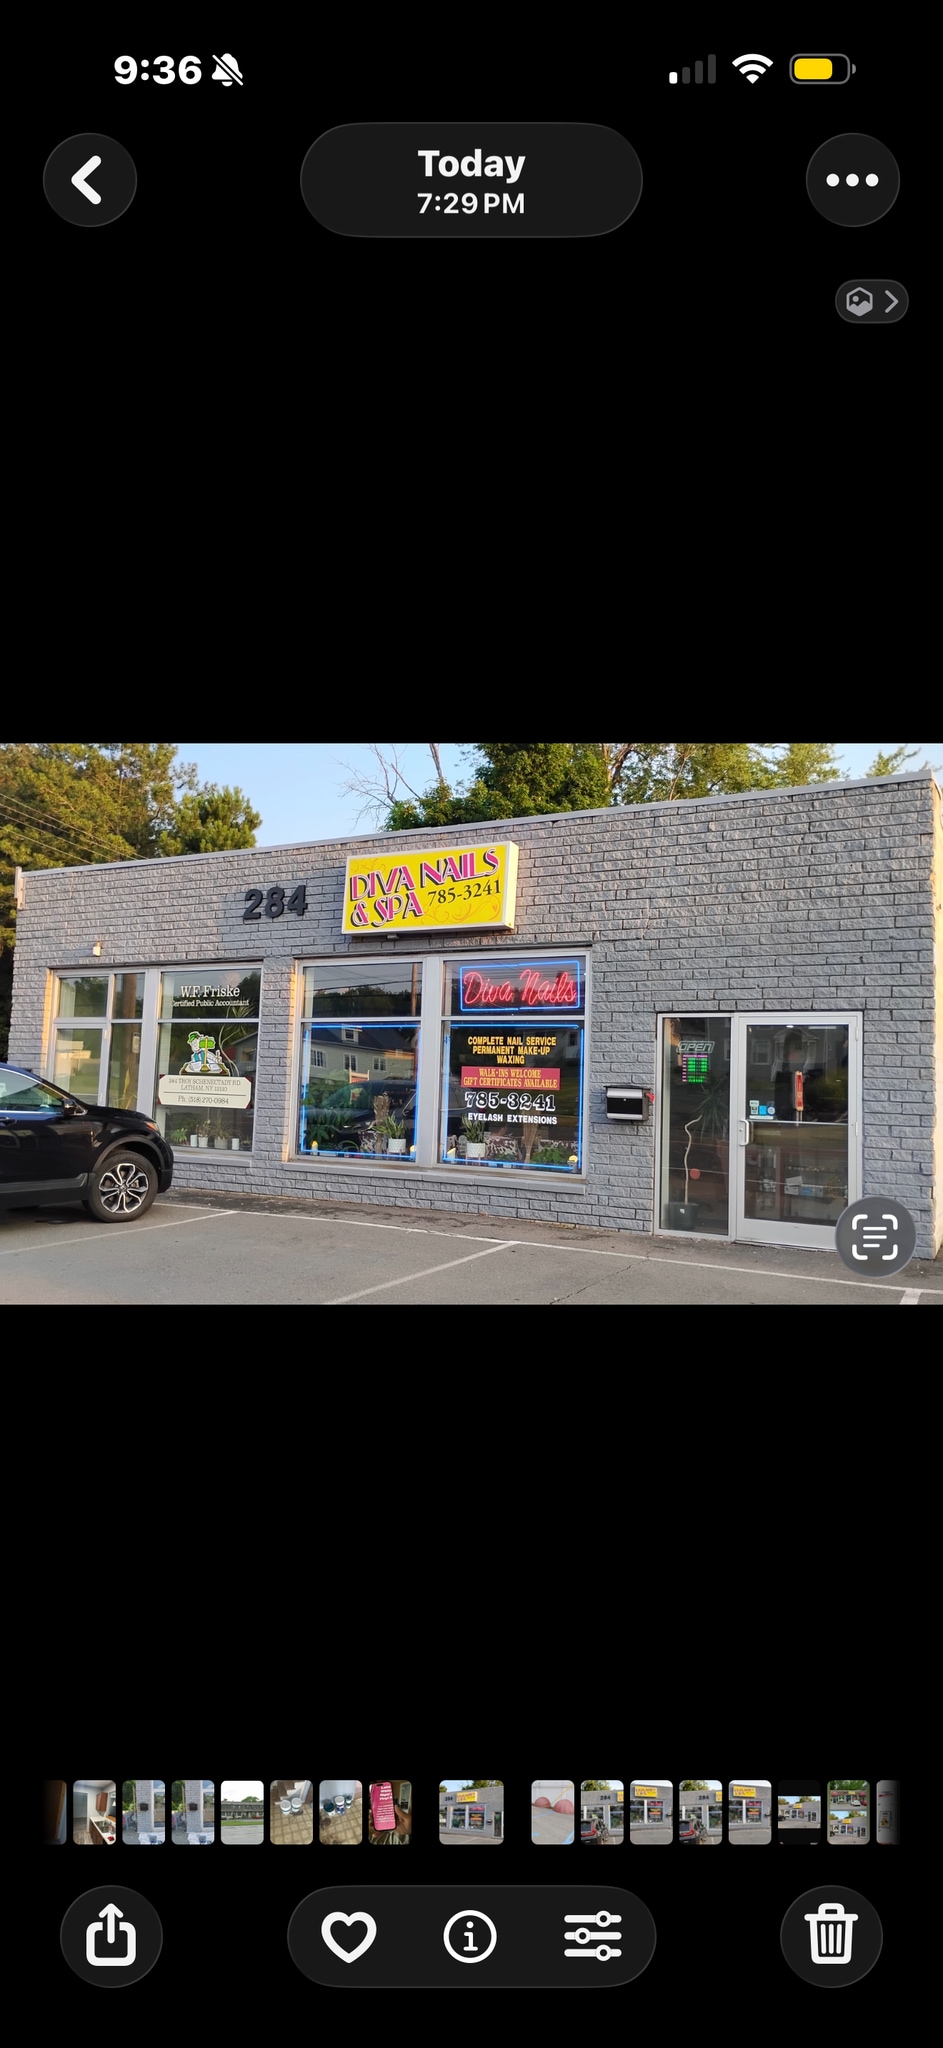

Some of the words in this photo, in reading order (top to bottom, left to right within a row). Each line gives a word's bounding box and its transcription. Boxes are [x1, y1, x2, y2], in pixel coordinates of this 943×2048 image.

[350, 865, 417, 901] DIVA
[420, 848, 499, 888] NAILS
[427, 879, 501, 907] 785-3241
[243, 885, 308, 920] 284
[351, 902, 370, 927] &
[373, 891, 424, 927] SPA
[202, 985, 240, 998] Friske
[463, 971, 514, 1005] Diva
[519, 969, 577, 1005] Nails
[170, 999, 194, 1007] Certified
[215, 999, 249, 1007] Accountant
[467, 1036, 504, 1046] COMPLETE
[507, 1036, 523, 1046] NAIL
[526, 1036, 557, 1046] SERVICE
[679, 1043, 712, 1051] OPEN
[472, 1045, 515, 1055] PERMANENT
[517, 1046, 551, 1055] MAKE-UP
[497, 1055, 525, 1065] WAXING
[479, 1068, 509, 1078] WALK-INS
[510, 1068, 542, 1079] WELCOME
[463, 1077, 478, 1086] GIFT
[479, 1077, 522, 1088] CERTIFICATES
[524, 1078, 558, 1089] AVAILABLE
[464, 1091, 557, 1112] 785-3241
[467, 1112, 504, 1122] EYELASH
[507, 1114, 558, 1125] EXTENSIONS
